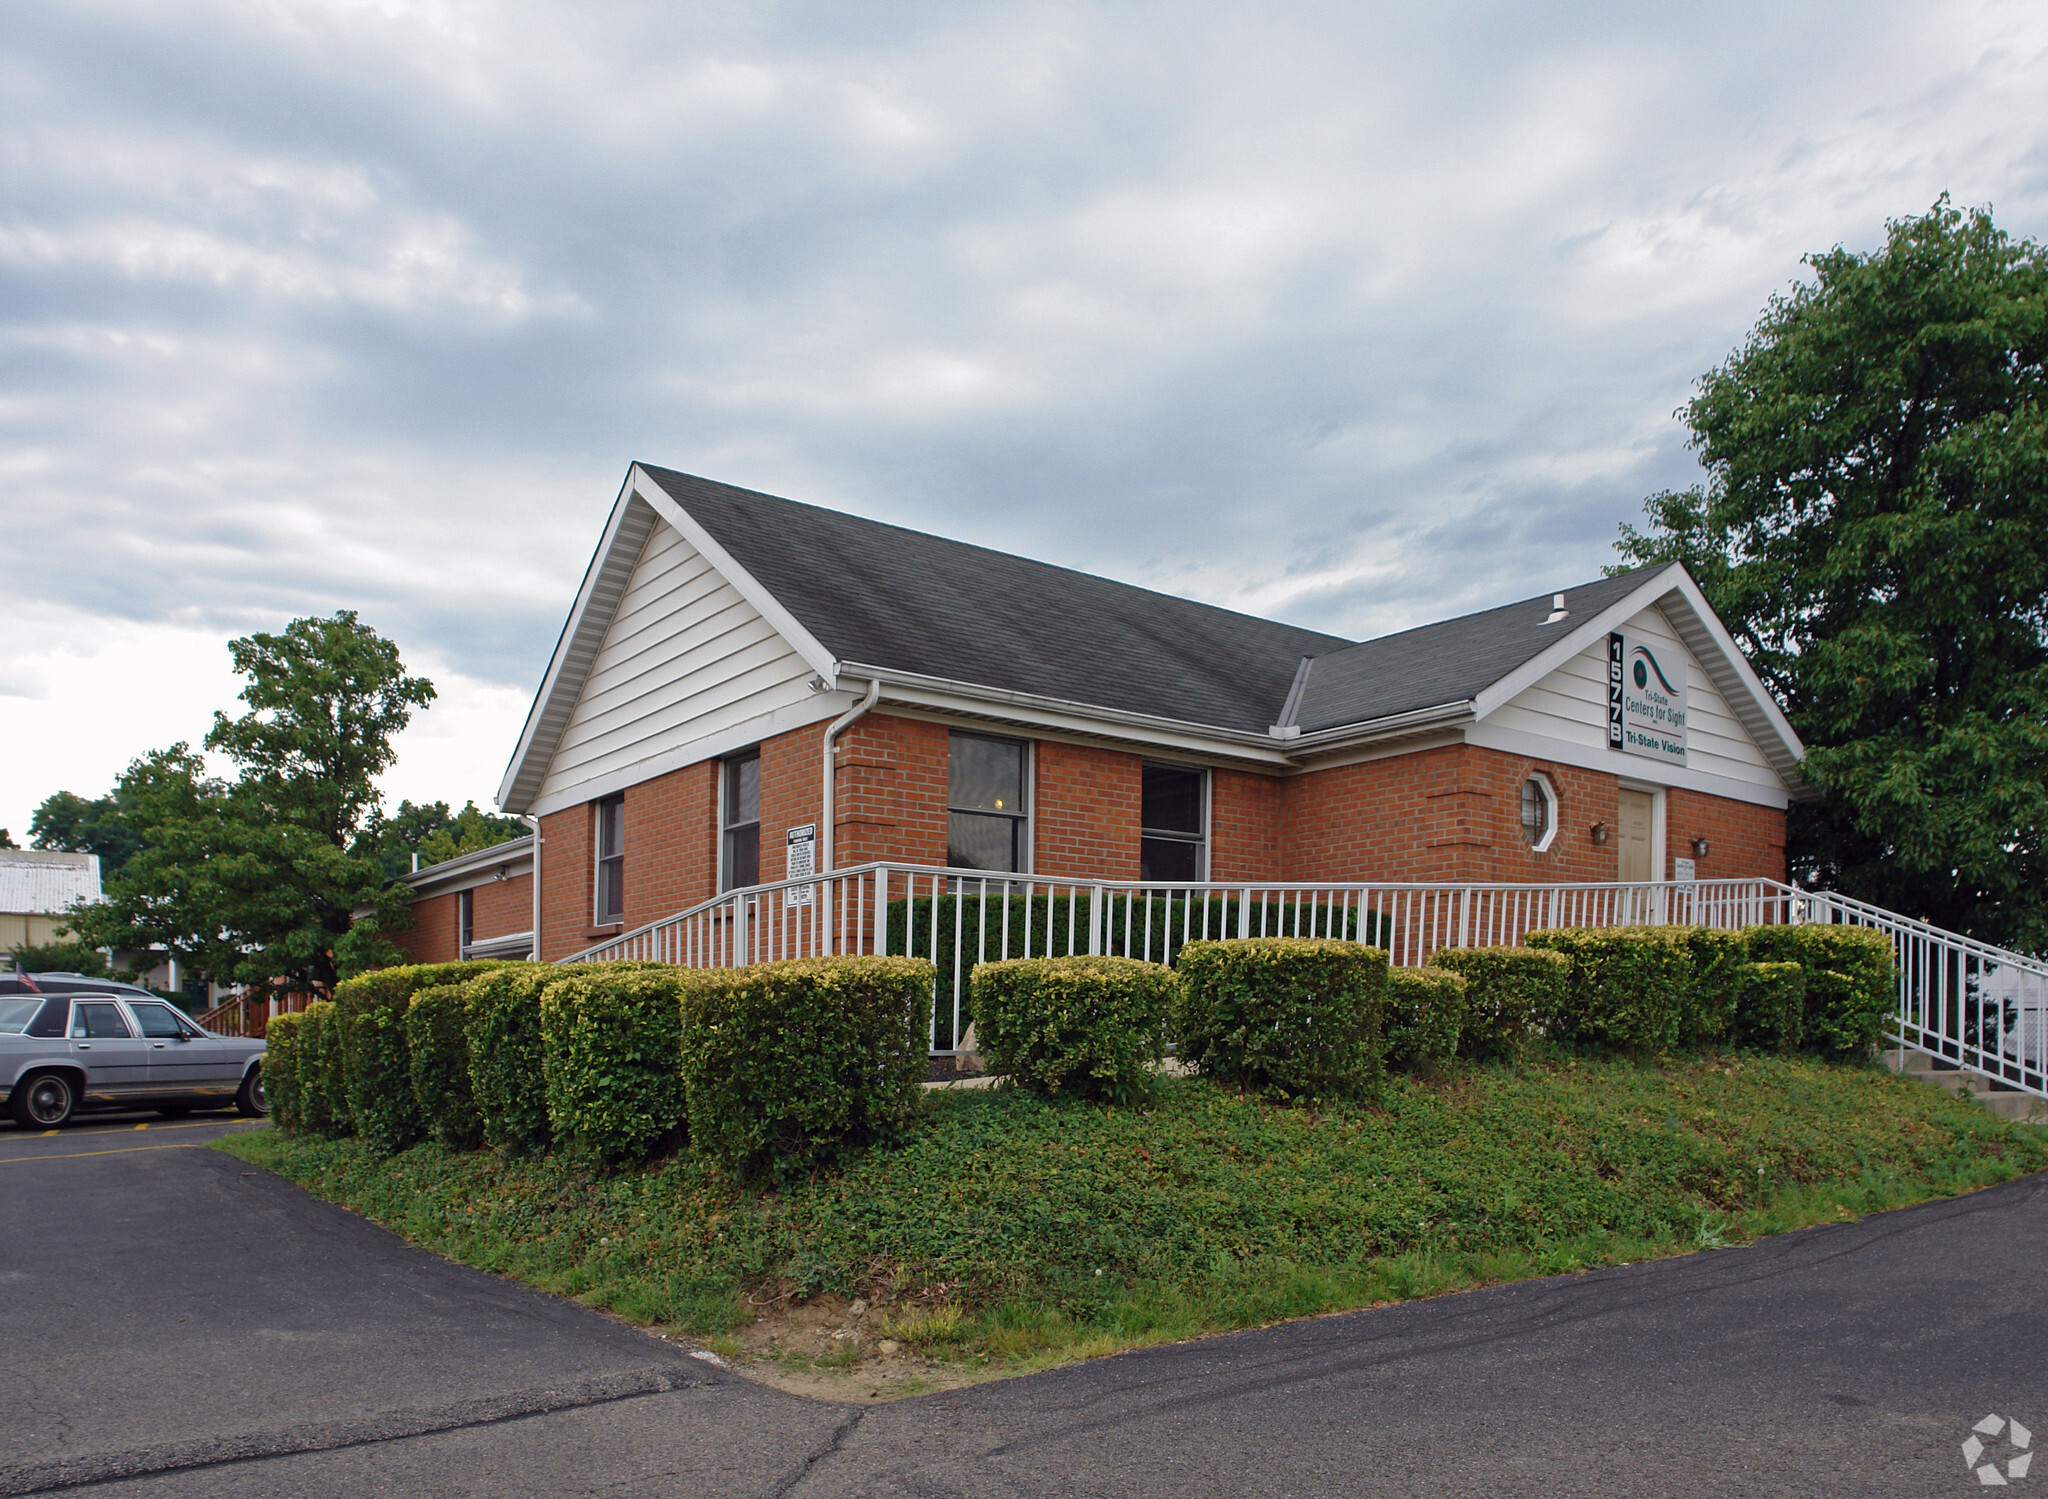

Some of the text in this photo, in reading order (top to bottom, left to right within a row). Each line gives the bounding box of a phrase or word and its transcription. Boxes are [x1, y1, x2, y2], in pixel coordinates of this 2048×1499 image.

[1610, 641, 1622, 741] 1577B
[1645, 689, 1668, 706] Tri-State
[1625, 695, 1685, 727] Centers for Sight
[1626, 730, 1685, 756] Tri-State Vision
